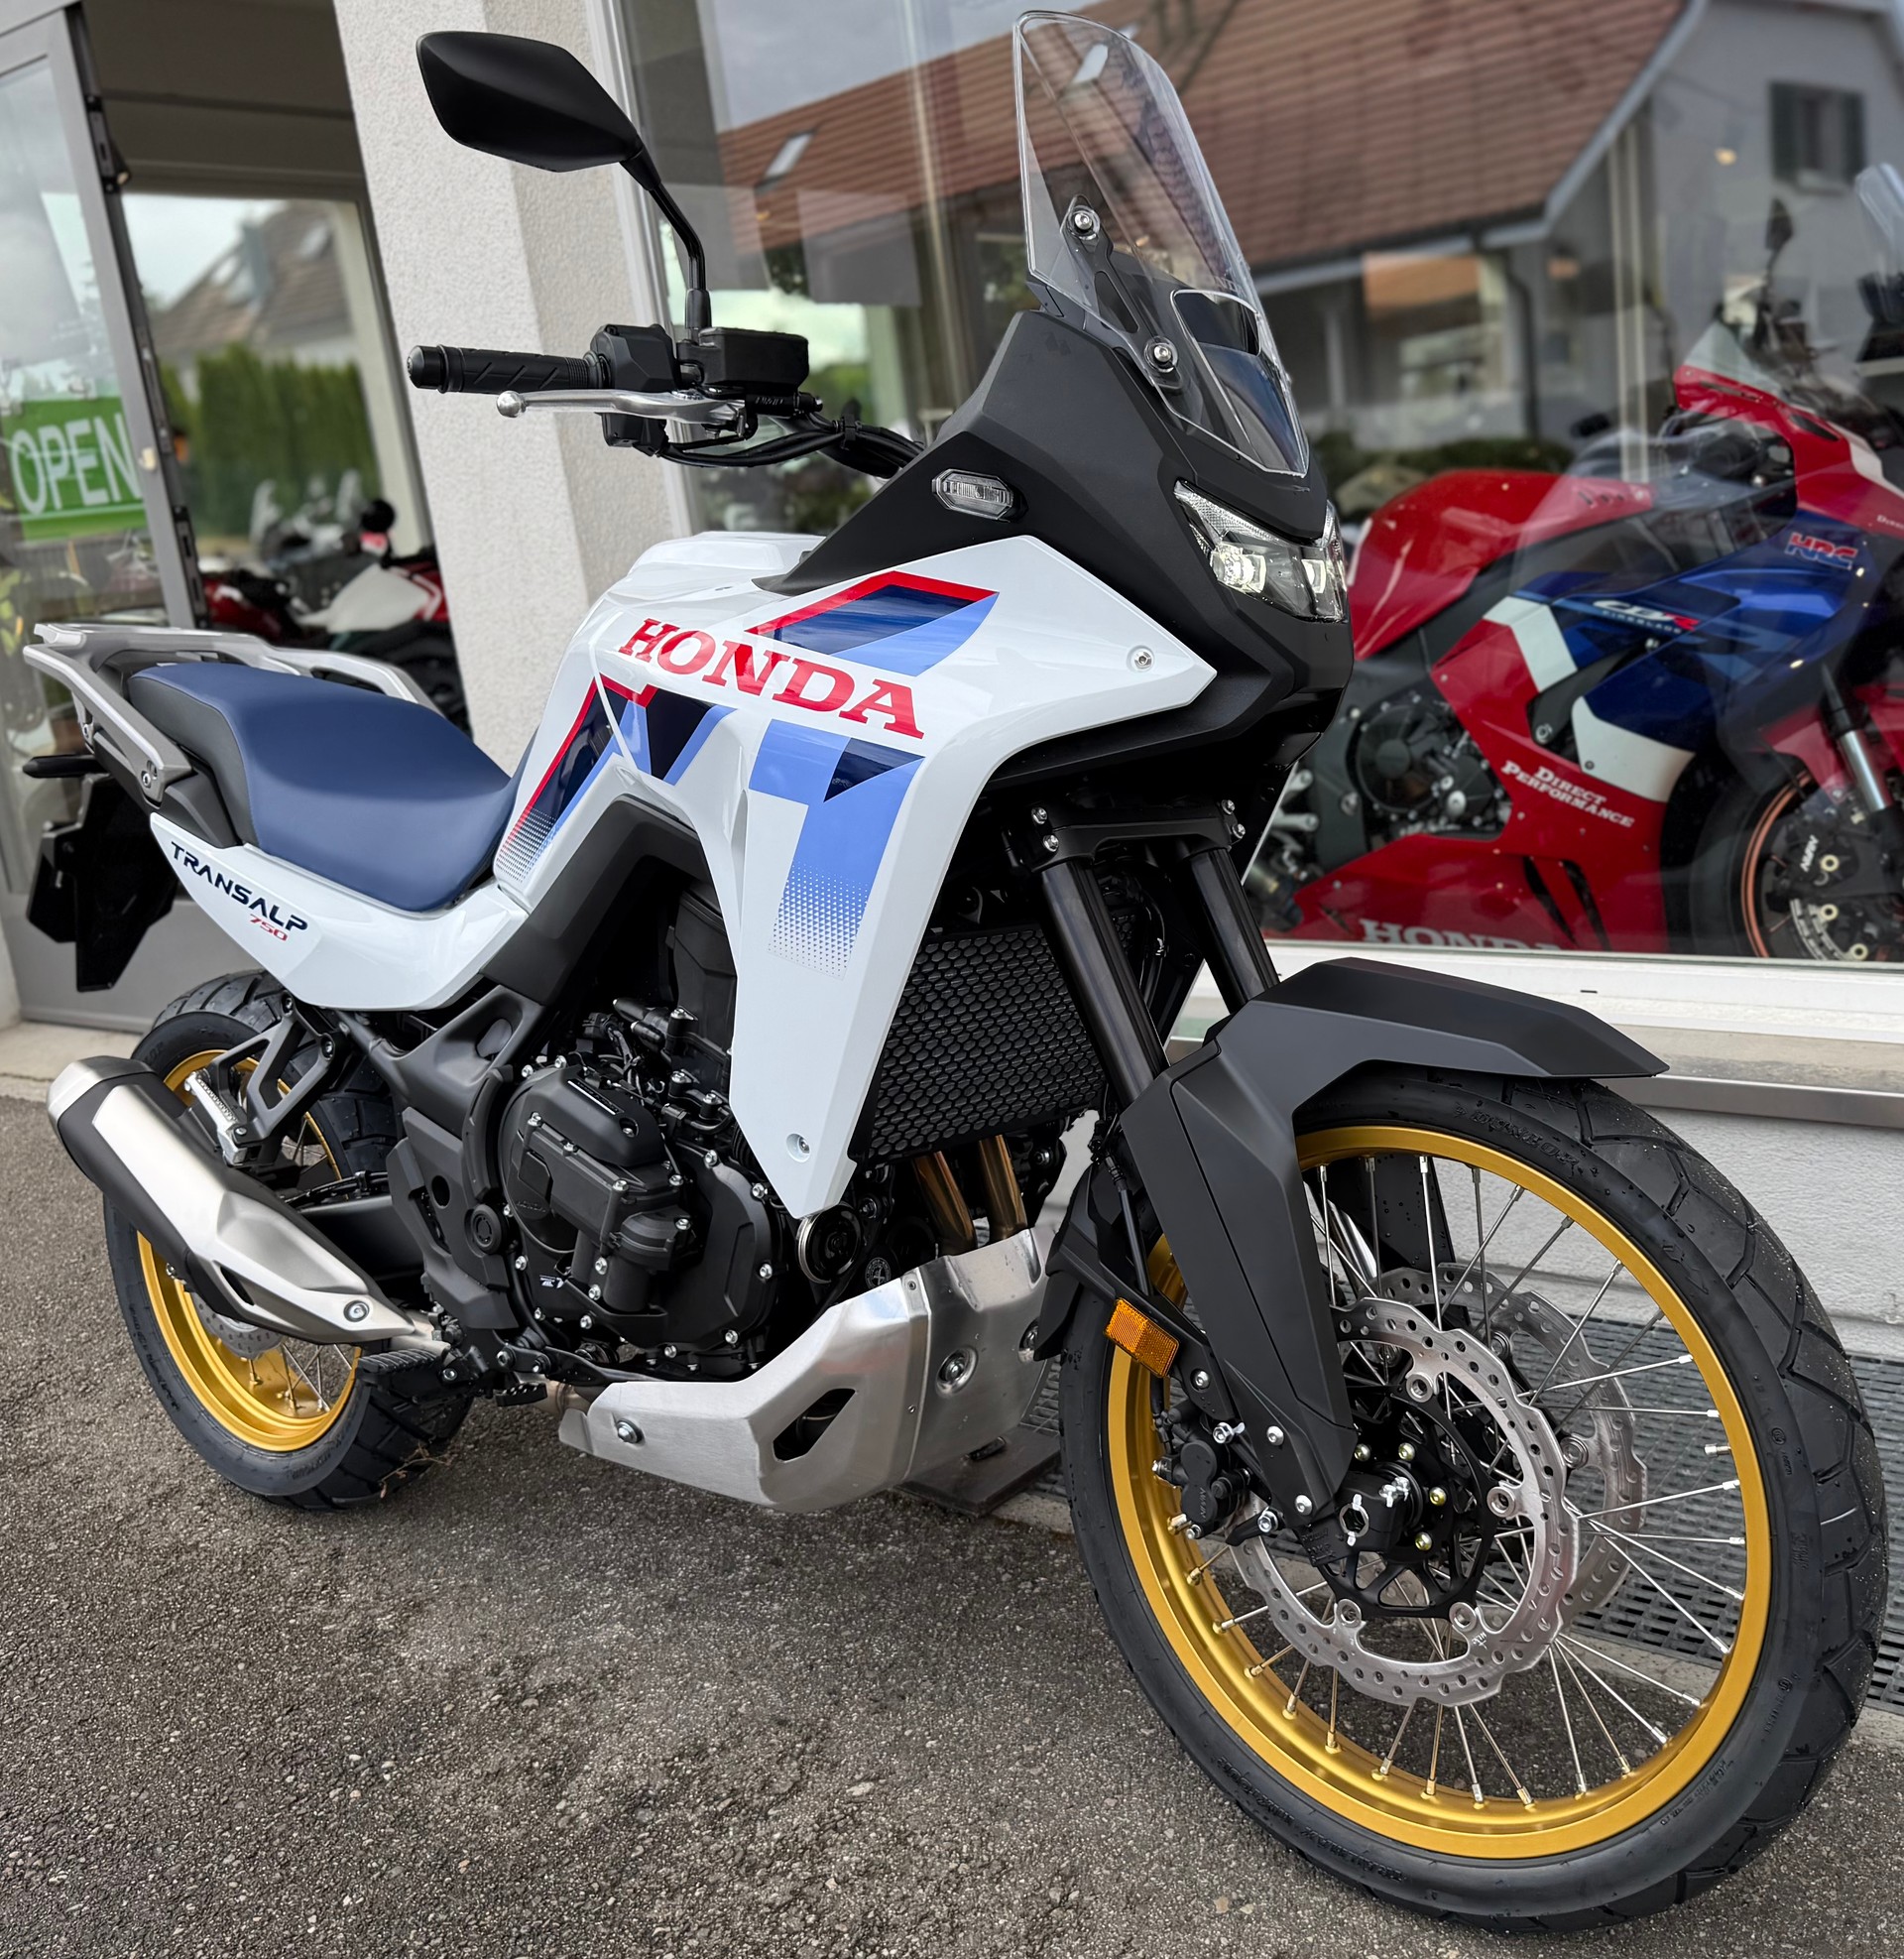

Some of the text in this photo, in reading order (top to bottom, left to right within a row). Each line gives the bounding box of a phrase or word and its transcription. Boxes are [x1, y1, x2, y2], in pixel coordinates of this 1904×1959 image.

[11, 413, 142, 515] OPEN
[1785, 532, 1857, 570] HRC
[618, 618, 924, 739] HONDA
[1500, 760, 1634, 827] PERFORMANCE
[1535, 766, 1606, 804] DIRECT
[172, 841, 307, 930] TRANSALP
[250, 914, 288, 941] 750
